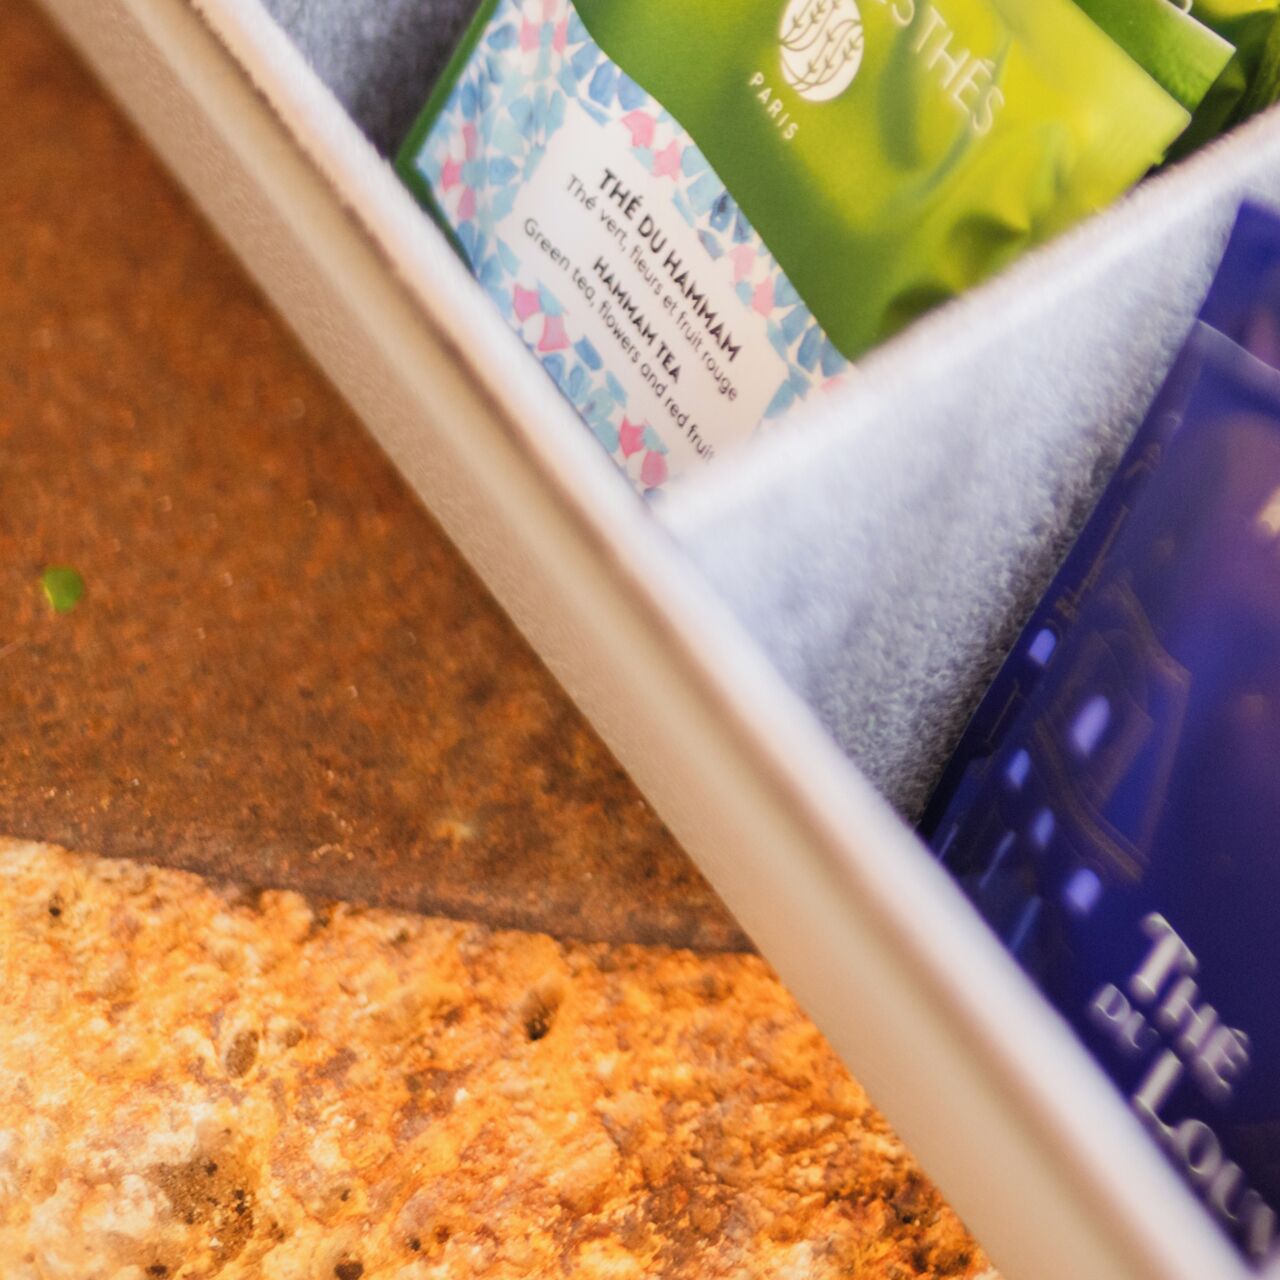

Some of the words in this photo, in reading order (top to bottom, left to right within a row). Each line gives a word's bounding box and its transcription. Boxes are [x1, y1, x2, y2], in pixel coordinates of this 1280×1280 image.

[749, 71, 799, 141] PARIS
[916, 5, 1005, 136] THÉS
[523, 218, 571, 272] Green
[571, 267, 596, 308] tea,
[598, 301, 640, 363] flowers
[640, 361, 667, 402] and
[664, 393, 689, 429] red
[565, 173, 597, 211] Thé
[599, 210, 628, 252] vert,
[629, 245, 663, 296] fleurs
[663, 295, 677, 317] et
[675, 310, 703, 352] fruit
[701, 350, 738, 403] rouge
[592, 256, 656, 347] HAMMAM
[658, 340, 681, 384] TEA
[598, 167, 644, 218] THÉ
[637, 217, 667, 254] DU
[663, 249, 743, 362] HAMMAM
